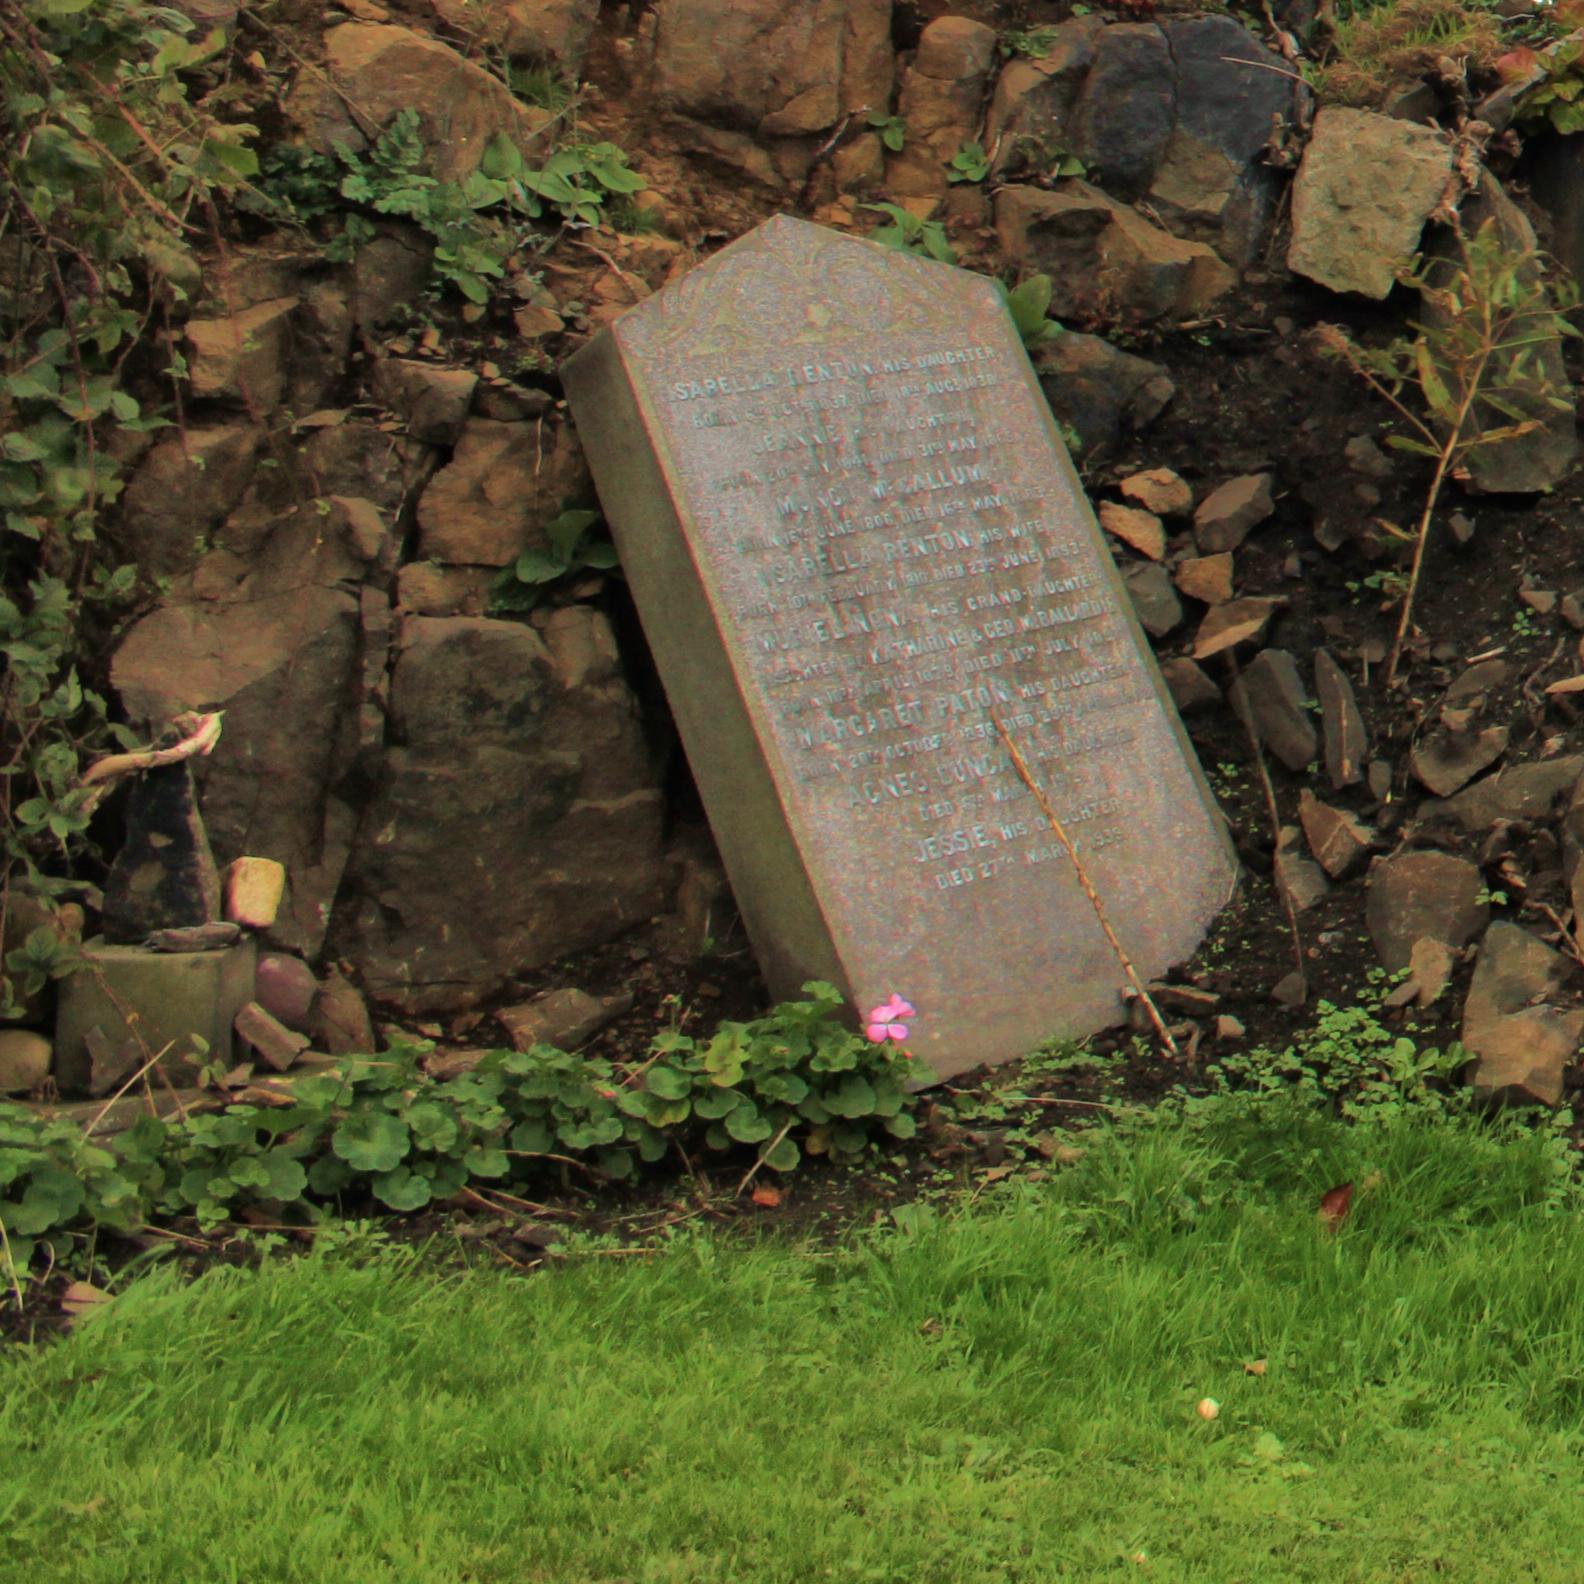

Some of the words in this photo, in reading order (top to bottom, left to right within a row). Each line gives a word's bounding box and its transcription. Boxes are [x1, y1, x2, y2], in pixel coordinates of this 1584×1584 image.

[665, 369, 776, 402] ISABELLA
[880, 356, 912, 372] HIS
[898, 505, 936, 523] DIED
[975, 527, 1004, 543] HIS
[931, 564, 966, 582] DIED
[927, 600, 961, 618] HIS
[968, 628, 983, 642] &
[961, 652, 1003, 673] DIED
[793, 699, 927, 749] MARGARET
[1017, 679, 1047, 698] HIS
[998, 712, 1037, 733] DIED
[841, 767, 930, 809] AGNES
[988, 777, 1044, 803] MARH
[907, 822, 997, 865] JESSIE,
[997, 820, 1029, 840] HIS
[933, 865, 975, 890] DIED
